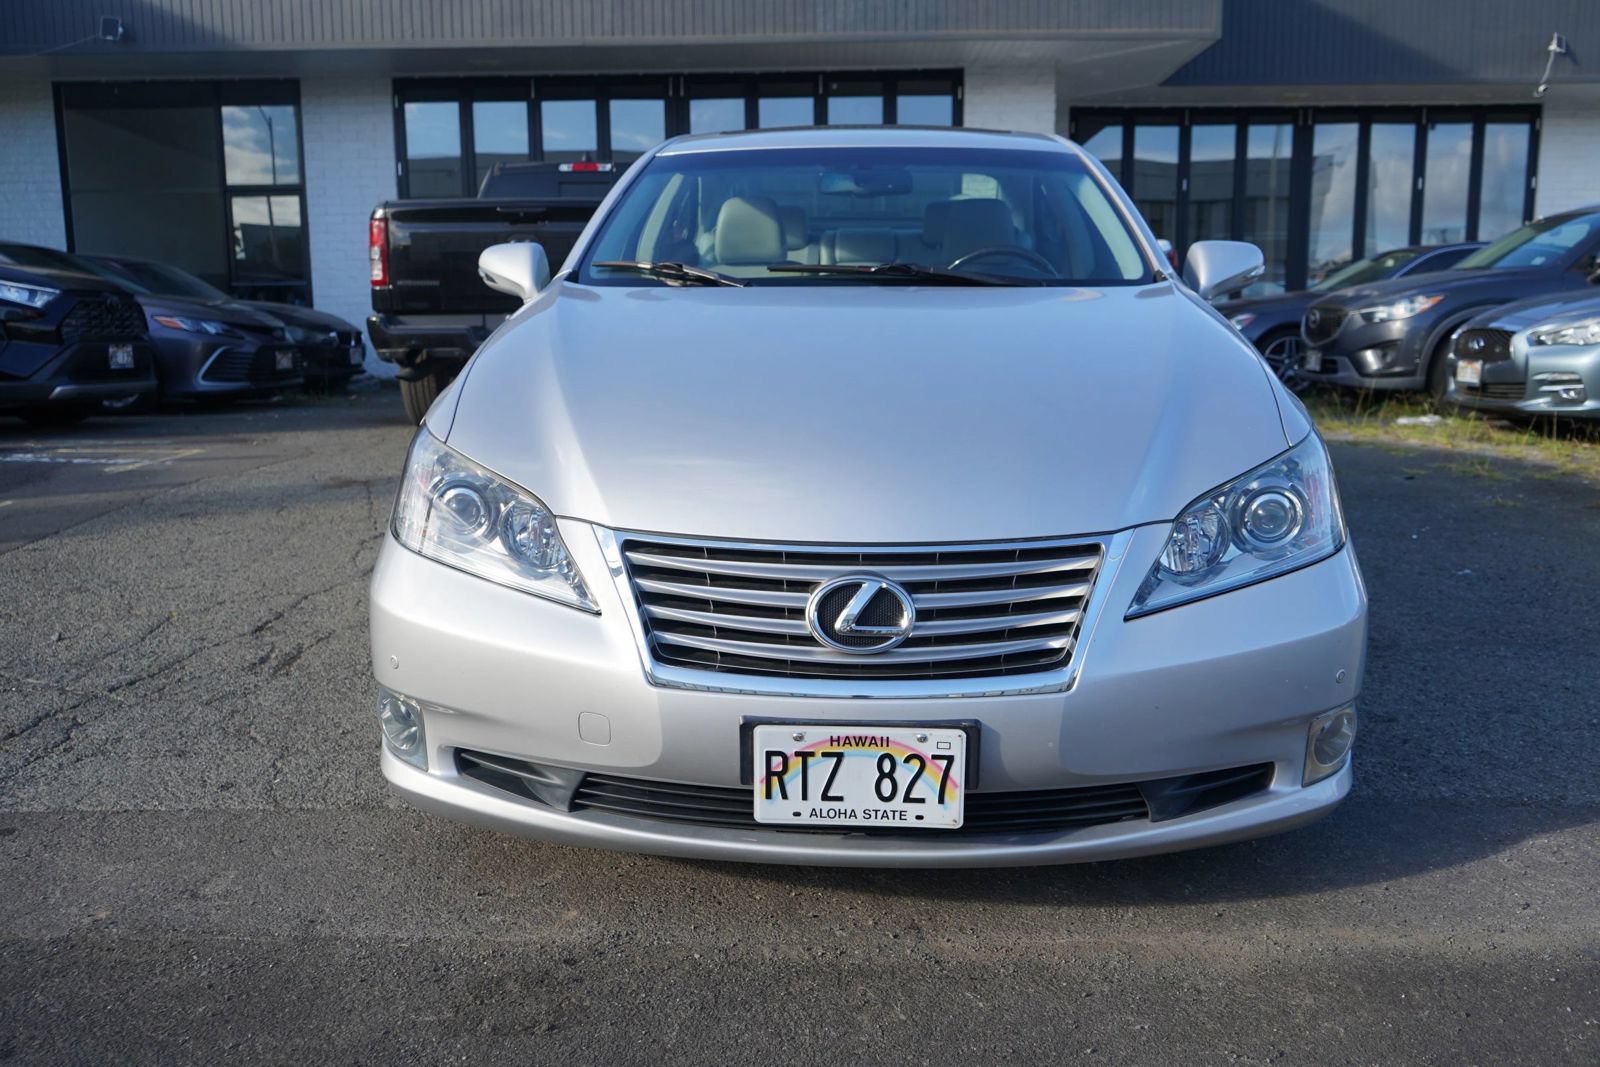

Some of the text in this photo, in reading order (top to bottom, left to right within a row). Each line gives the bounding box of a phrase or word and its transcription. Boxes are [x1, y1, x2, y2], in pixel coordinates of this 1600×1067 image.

[829, 735, 890, 748] HAWAII
[764, 750, 955, 804] RTZ 827
[809, 808, 908, 821] ALOHA STATE
